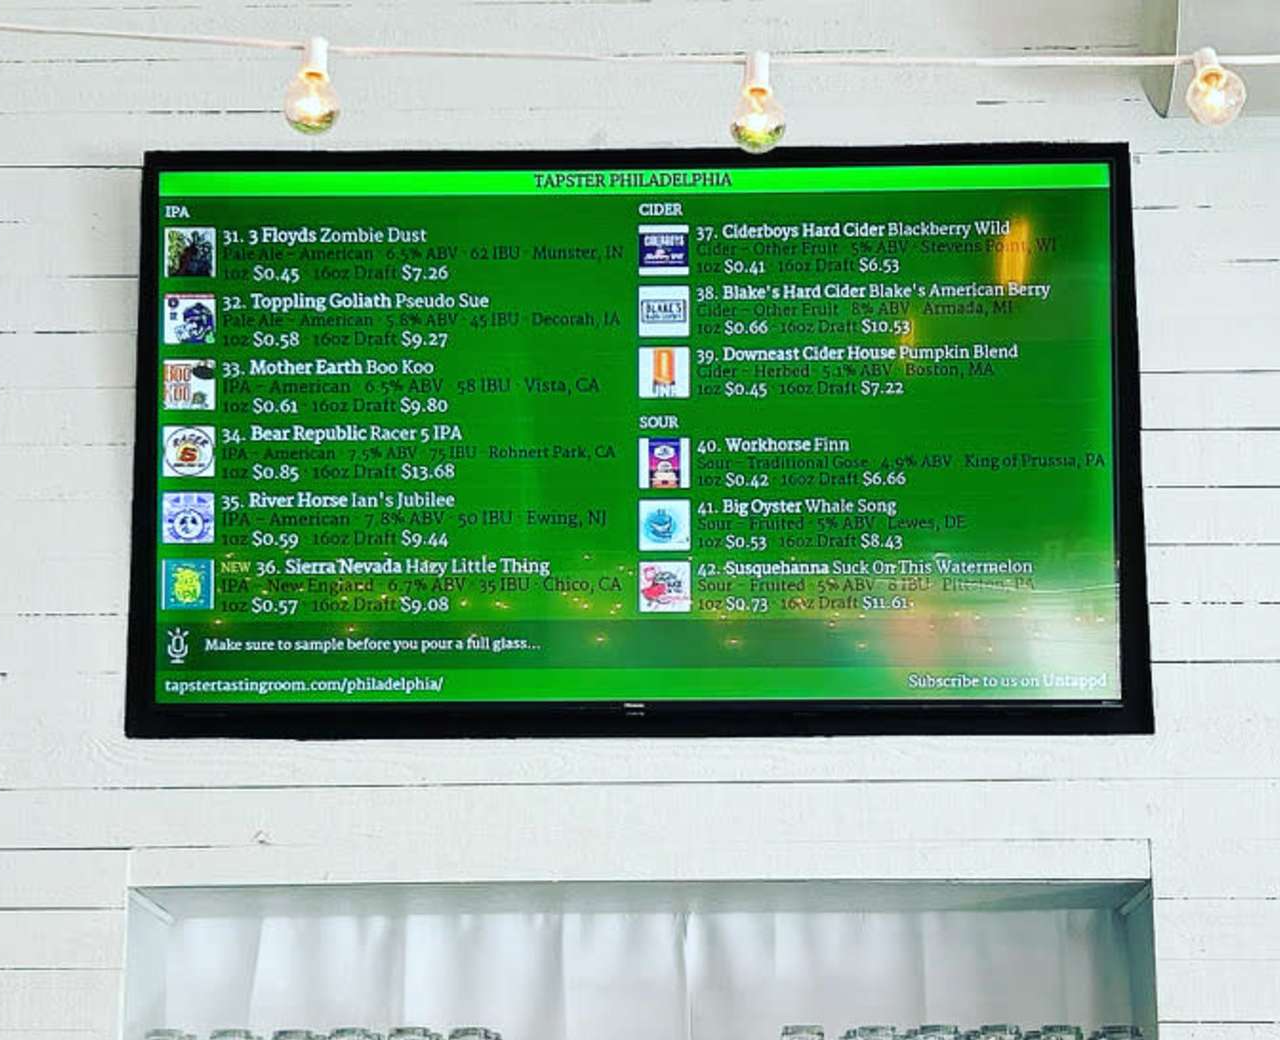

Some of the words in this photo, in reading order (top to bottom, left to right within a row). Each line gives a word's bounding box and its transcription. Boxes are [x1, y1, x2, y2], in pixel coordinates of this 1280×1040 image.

[534, 173, 606, 188] TAPSTER
[610, 172, 732, 187] PHILADELPHIA
[165, 205, 191, 218] IPA
[638, 202, 683, 216] CIDER
[696, 226, 718, 242] 37.
[721, 223, 800, 242] Ciderboys
[802, 222, 841, 238] Hard
[842, 222, 886, 237] Cider
[887, 221, 972, 240] Blackberry
[974, 219, 1010, 235] Wild
[222, 296, 246, 312] 32.
[250, 292, 327, 313] Toppling
[328, 292, 393, 309] Goliath
[395, 292, 455, 309] Pseudo
[458, 292, 490, 308] Sue
[861, 317, 913, 337] $10.53
[222, 362, 245, 378] 33.
[249, 359, 314, 376] Mother
[315, 358, 364, 375] Earth
[365, 359, 399, 375] Boo
[402, 359, 434, 375] Koo
[639, 415, 679, 429] SOUR
[697, 439, 721, 455] 40.
[724, 437, 812, 453] Workhorse
[813, 437, 850, 452] Finn
[401, 462, 455, 481] $13.68
[221, 560, 251, 573] NEW
[165, 676, 444, 696] tapstertastingroom.com/philadelphia/
